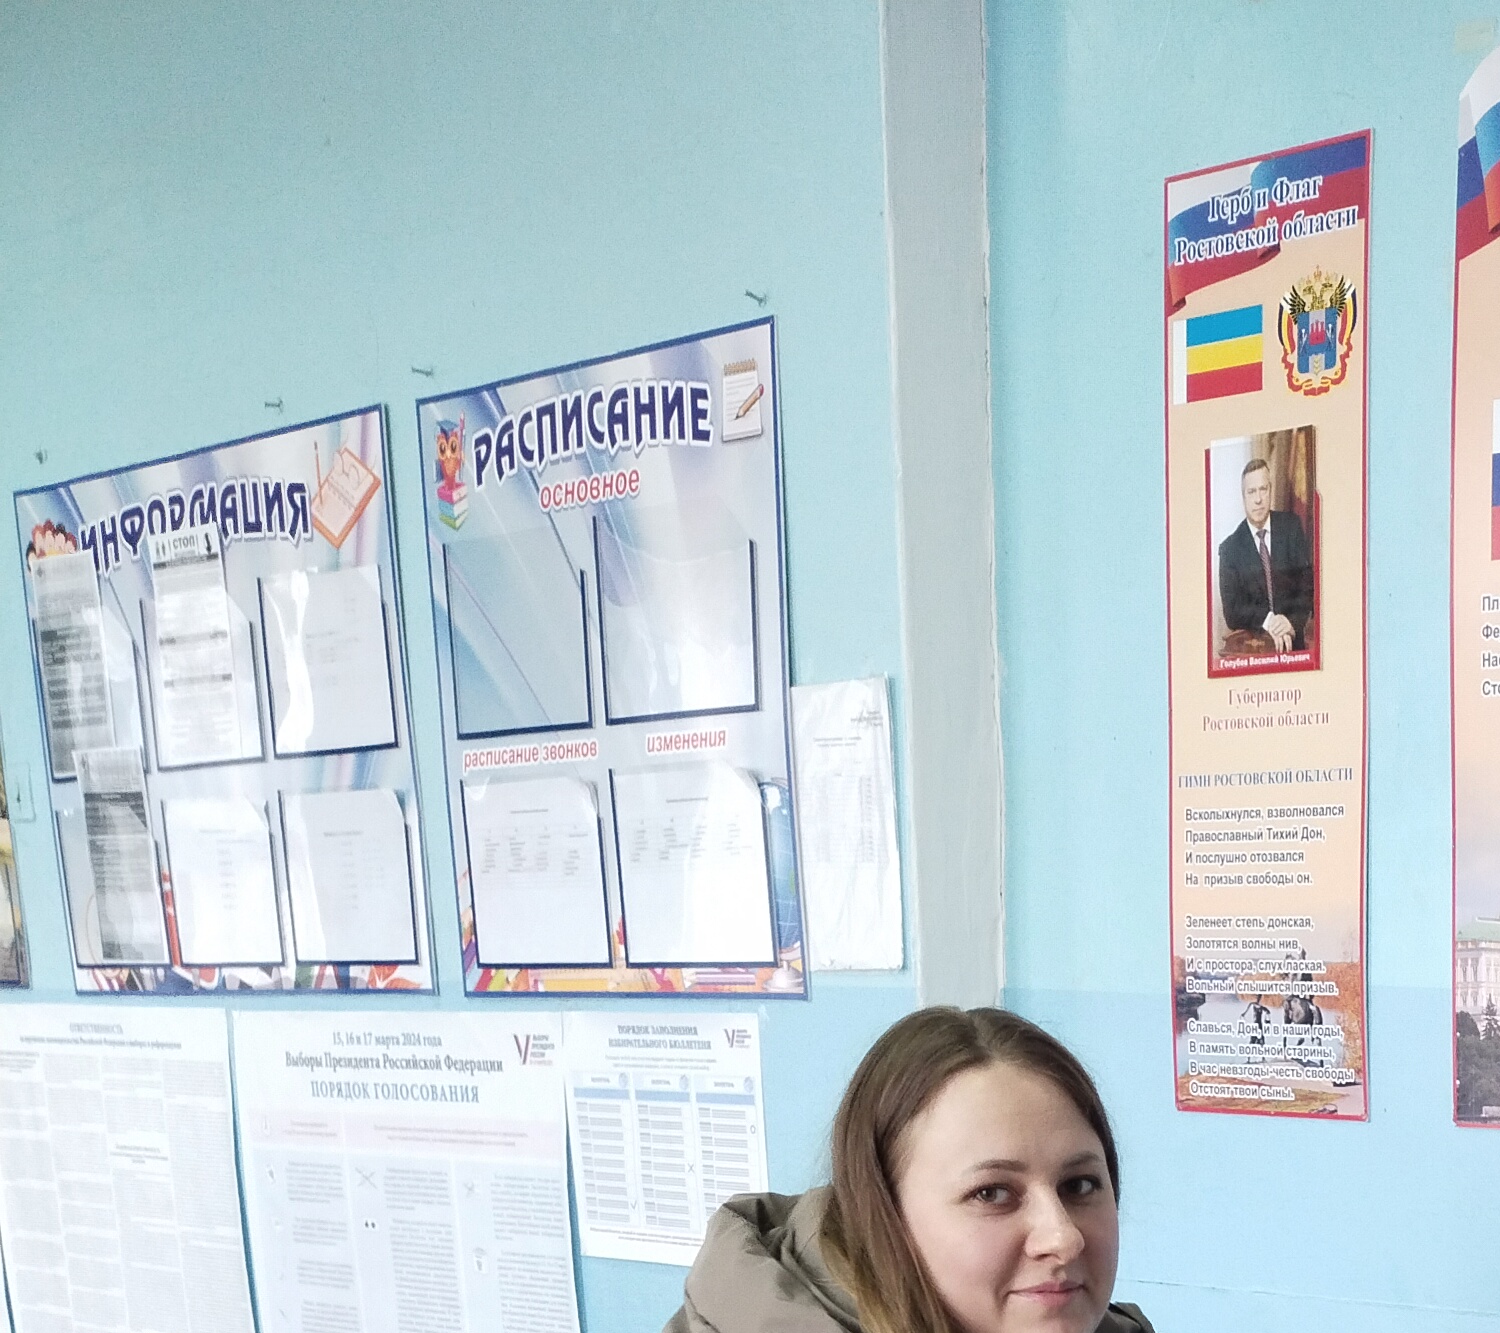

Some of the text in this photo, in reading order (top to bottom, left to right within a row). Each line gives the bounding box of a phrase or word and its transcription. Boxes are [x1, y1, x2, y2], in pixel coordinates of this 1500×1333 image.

[1211, 178, 1321, 221] Герб и Флаг
[1176, 209, 1356, 262] Ростовской области
[474, 384, 711, 486] РАСПИСАНИЕ
[540, 469, 640, 509] основное
[80, 482, 309, 576] ИНФОРМАЦИЯ
[1228, 687, 1301, 708] Губернатор
[1203, 709, 1328, 731] Ростовской области
[646, 729, 725, 752] изменения
[464, 741, 597, 772] расписание звонков
[1178, 767, 1352, 788] ГИМН РОСТОВСКОЙ ОБЛАСТИ
[1185, 805, 1344, 822] Всколыхнулся, взволновался
[1185, 826, 1325, 845] Православный Тихий Дон,
[1185, 851, 1304, 866] И послушно отозвался
[1185, 871, 1312, 887] На призыв свободы он.
[285, 1051, 503, 1076] Выборы Президента Российской Федерации
[310, 1080, 479, 1103] ПОРЯДОК ГОЛОСОВАНИЯ
